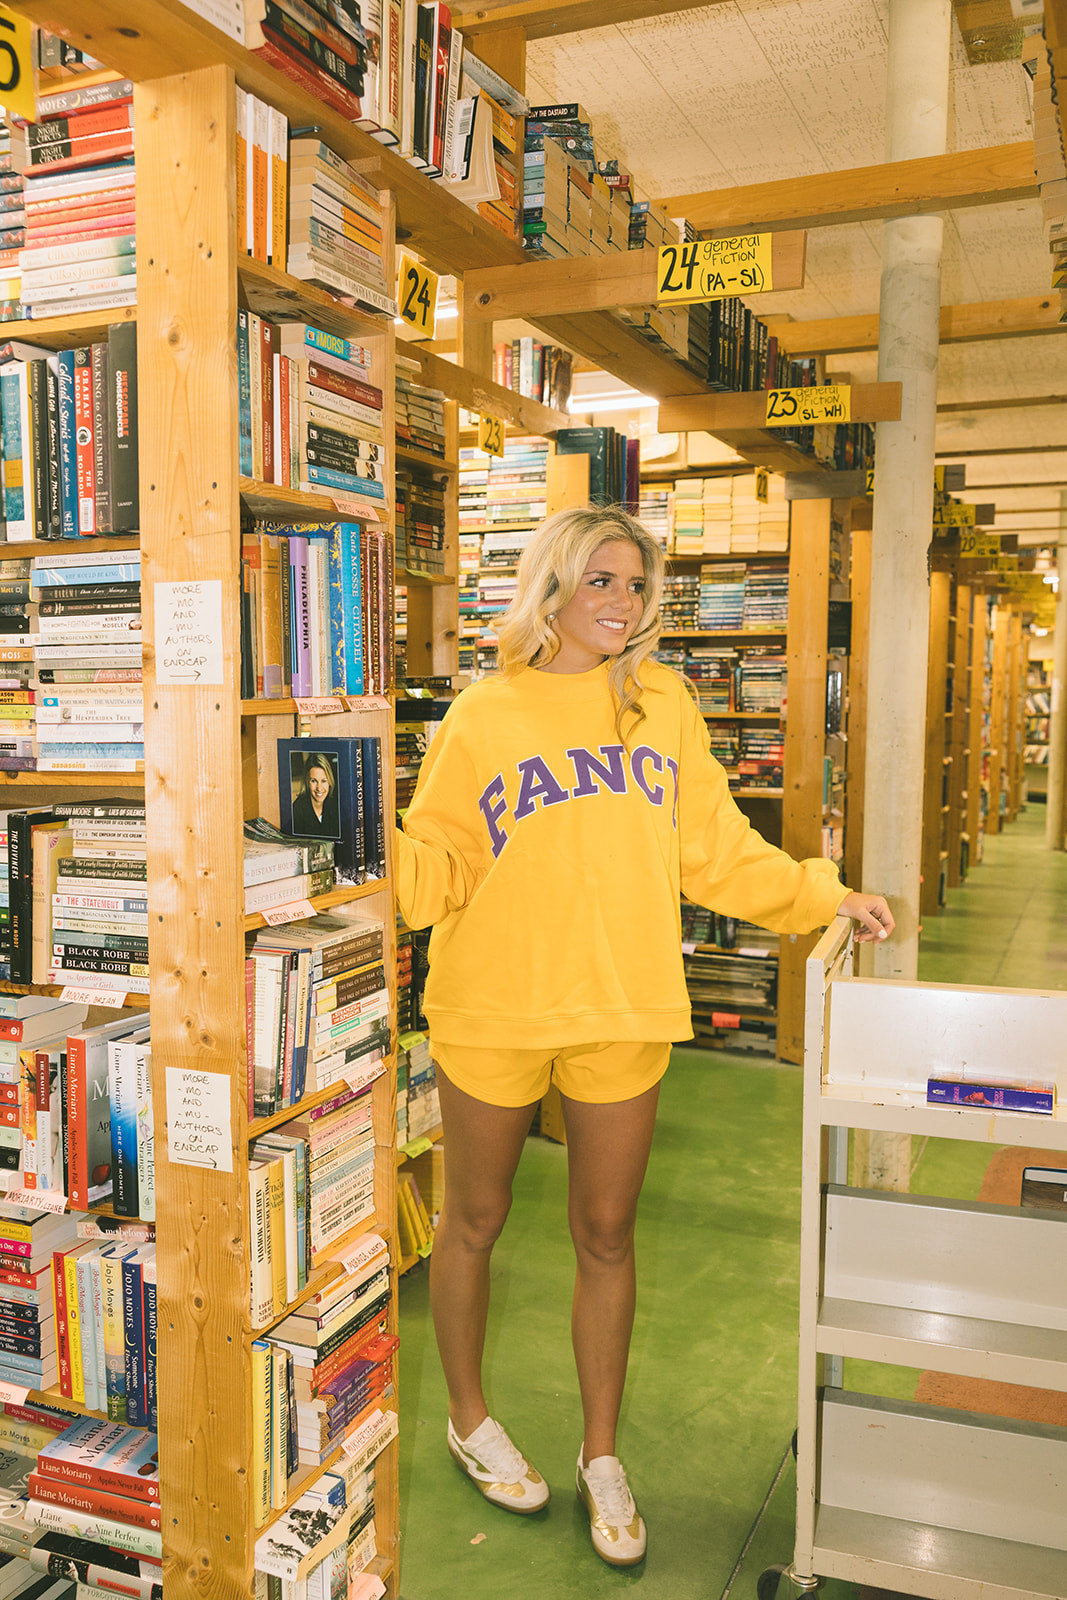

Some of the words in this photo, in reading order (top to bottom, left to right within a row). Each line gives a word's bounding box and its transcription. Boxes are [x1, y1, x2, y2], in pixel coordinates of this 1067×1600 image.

[36, 132, 62, 144] CIRCUS
[37, 125, 60, 135] NIGHT
[40, 145, 62, 156] NIGHT
[703, 235, 760, 260] general
[660, 243, 699, 293] 24
[402, 267, 431, 326] 24
[94, 348, 102, 399] WALKING
[82, 369, 90, 419] GRAHAM
[115, 370, 125, 439] CONSEQUENCES
[121, 371, 130, 437] INESCAPABLE
[767, 391, 798, 419] 23
[796, 385, 839, 403] general
[95, 401, 101, 411] to
[484, 417, 501, 453] 23
[96, 413, 104, 485] GATLINBURG
[351, 556, 359, 597] MOSSE
[172, 584, 202, 594] MORE
[172, 610, 196, 619] AND
[301, 565, 310, 650] PHILADELPHIA
[165, 635, 213, 646] AUTHORS
[352, 605, 361, 665] CITADEL
[163, 656, 208, 667] ENDCAP
[177, 648, 192, 657] ON
[55, 807, 72, 816] BRIAN
[72, 807, 92, 816] MOORE
[108, 808, 119, 816] LIES
[125, 809, 146, 817] SILENCE
[11, 830, 19, 844] THE
[11, 845, 19, 880] DIVINERS
[67, 896, 79, 906] THE
[82, 897, 119, 910] STATEMENT
[129, 902, 145, 910] BRIAN
[68, 947, 99, 957] BLACK
[103, 950, 130, 960] ROBE
[66, 959, 97, 970] BLACK
[100, 962, 128, 972] ROBE
[69, 1046, 78, 1074] Liane
[137, 1056, 145, 1101] Moriarty
[182, 1073, 210, 1085] MORE
[70, 1078, 78, 1122] Moriarty
[182, 1097, 203, 1107] AND
[174, 1120, 223, 1136] AUTHORS
[188, 1134, 203, 1143] ON
[173, 1141, 219, 1154] ENDCAP
[118, 1226, 142, 1238] before
[105, 1263, 113, 1285] Jojo
[106, 1288, 114, 1318] Moyes
[148, 1287, 156, 1309] JOJO
[125, 1297, 133, 1329] MOYES
[148, 1310, 156, 1340] MOYES
[111, 1395, 120, 1417] Stars
[10, 1430, 31, 1443] Moyes
[69, 1421, 109, 1450] Liane
[366, 1441, 379, 1460] BIG
[378, 1427, 393, 1449] WAR
[41, 1461, 60, 1474] Liane
[61, 1466, 93, 1483] Moriarty
[98, 1475, 117, 1486] Apples
[117, 1480, 133, 1490] Never
[133, 1483, 144, 1492] Fall
[35, 1485, 57, 1499] Liane
[58, 1492, 94, 1512] Moriarty
[99, 1505, 117, 1516] Apples
[117, 1510, 134, 1520] Never
[134, 1513, 145, 1523] Fall
[40, 1508, 63, 1522] Liane
[33, 1518, 68, 1534] Moriarty
[95, 1523, 113, 1537] Nine
[114, 1528, 141, 1544] Perfect
[100, 1536, 135, 1551] Strangers
